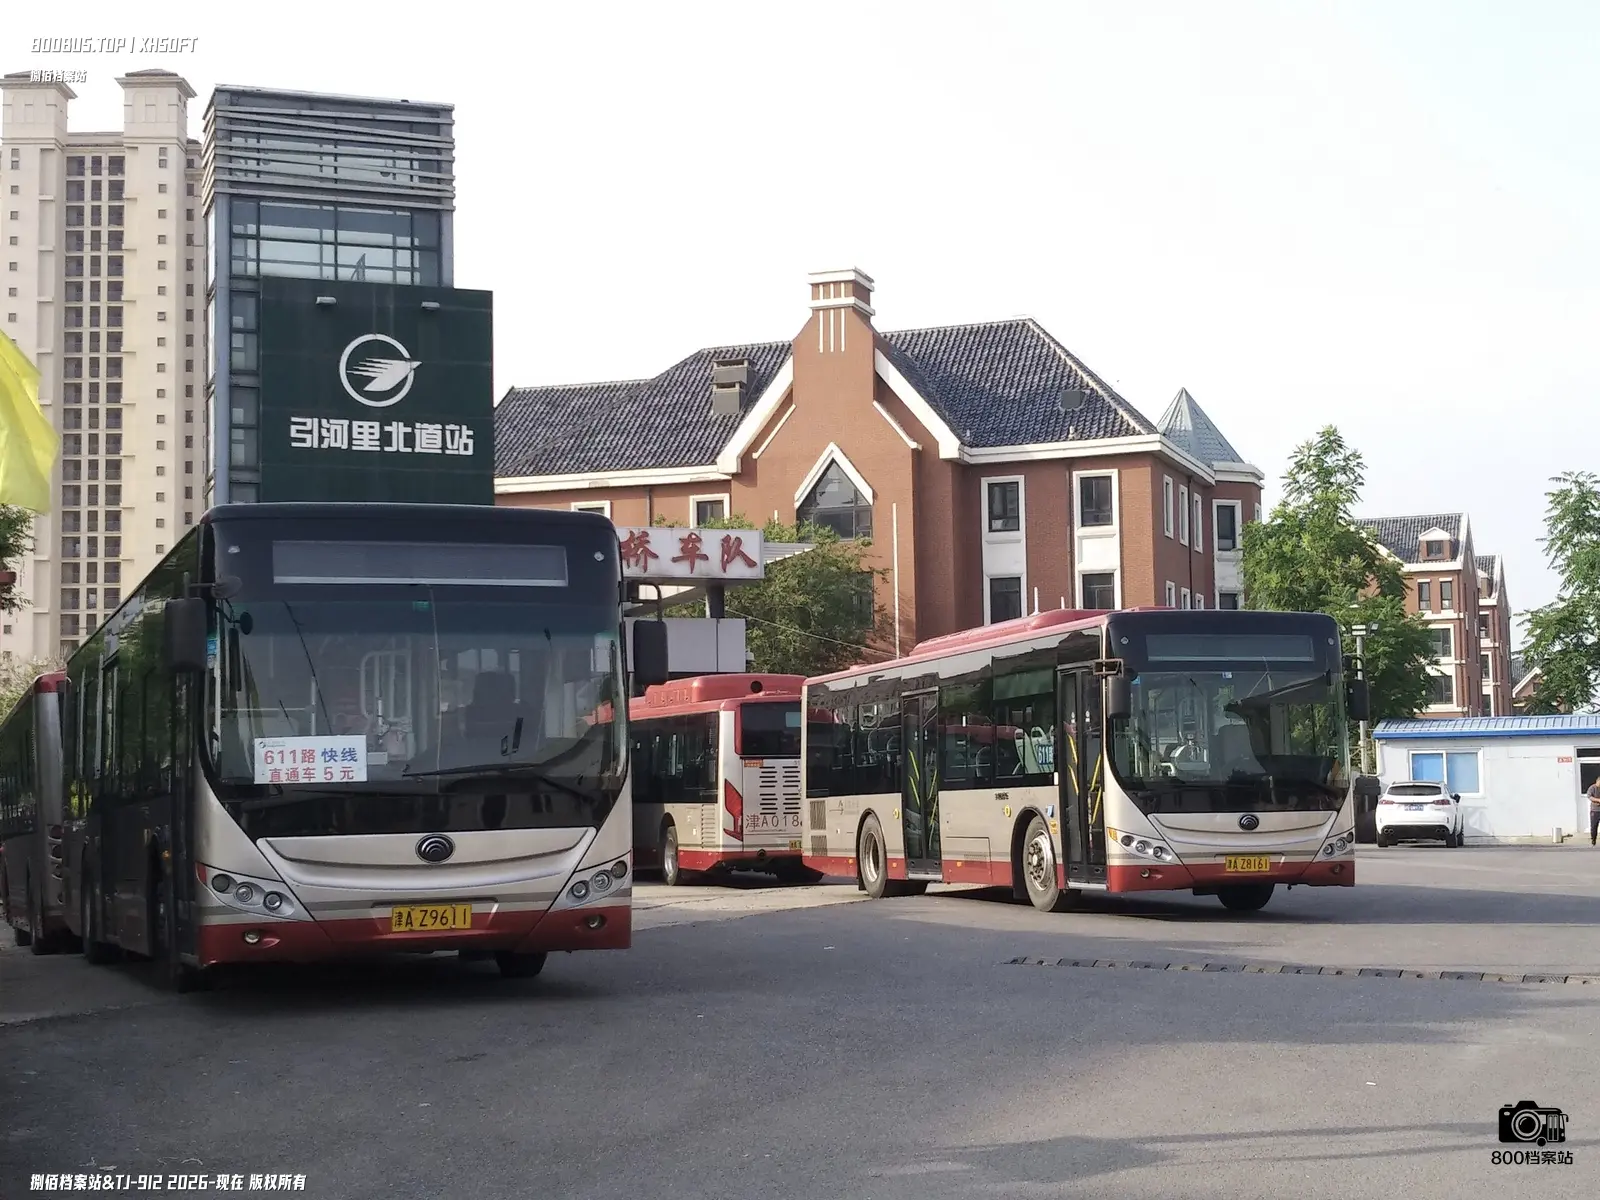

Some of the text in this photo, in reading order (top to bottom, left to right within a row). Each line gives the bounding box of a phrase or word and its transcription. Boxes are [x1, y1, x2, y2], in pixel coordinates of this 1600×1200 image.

[290, 416, 474, 456] 引河里北道站
[264, 747, 358, 765] 611路 快线
[269, 766, 355, 783] 直通车 5 元
